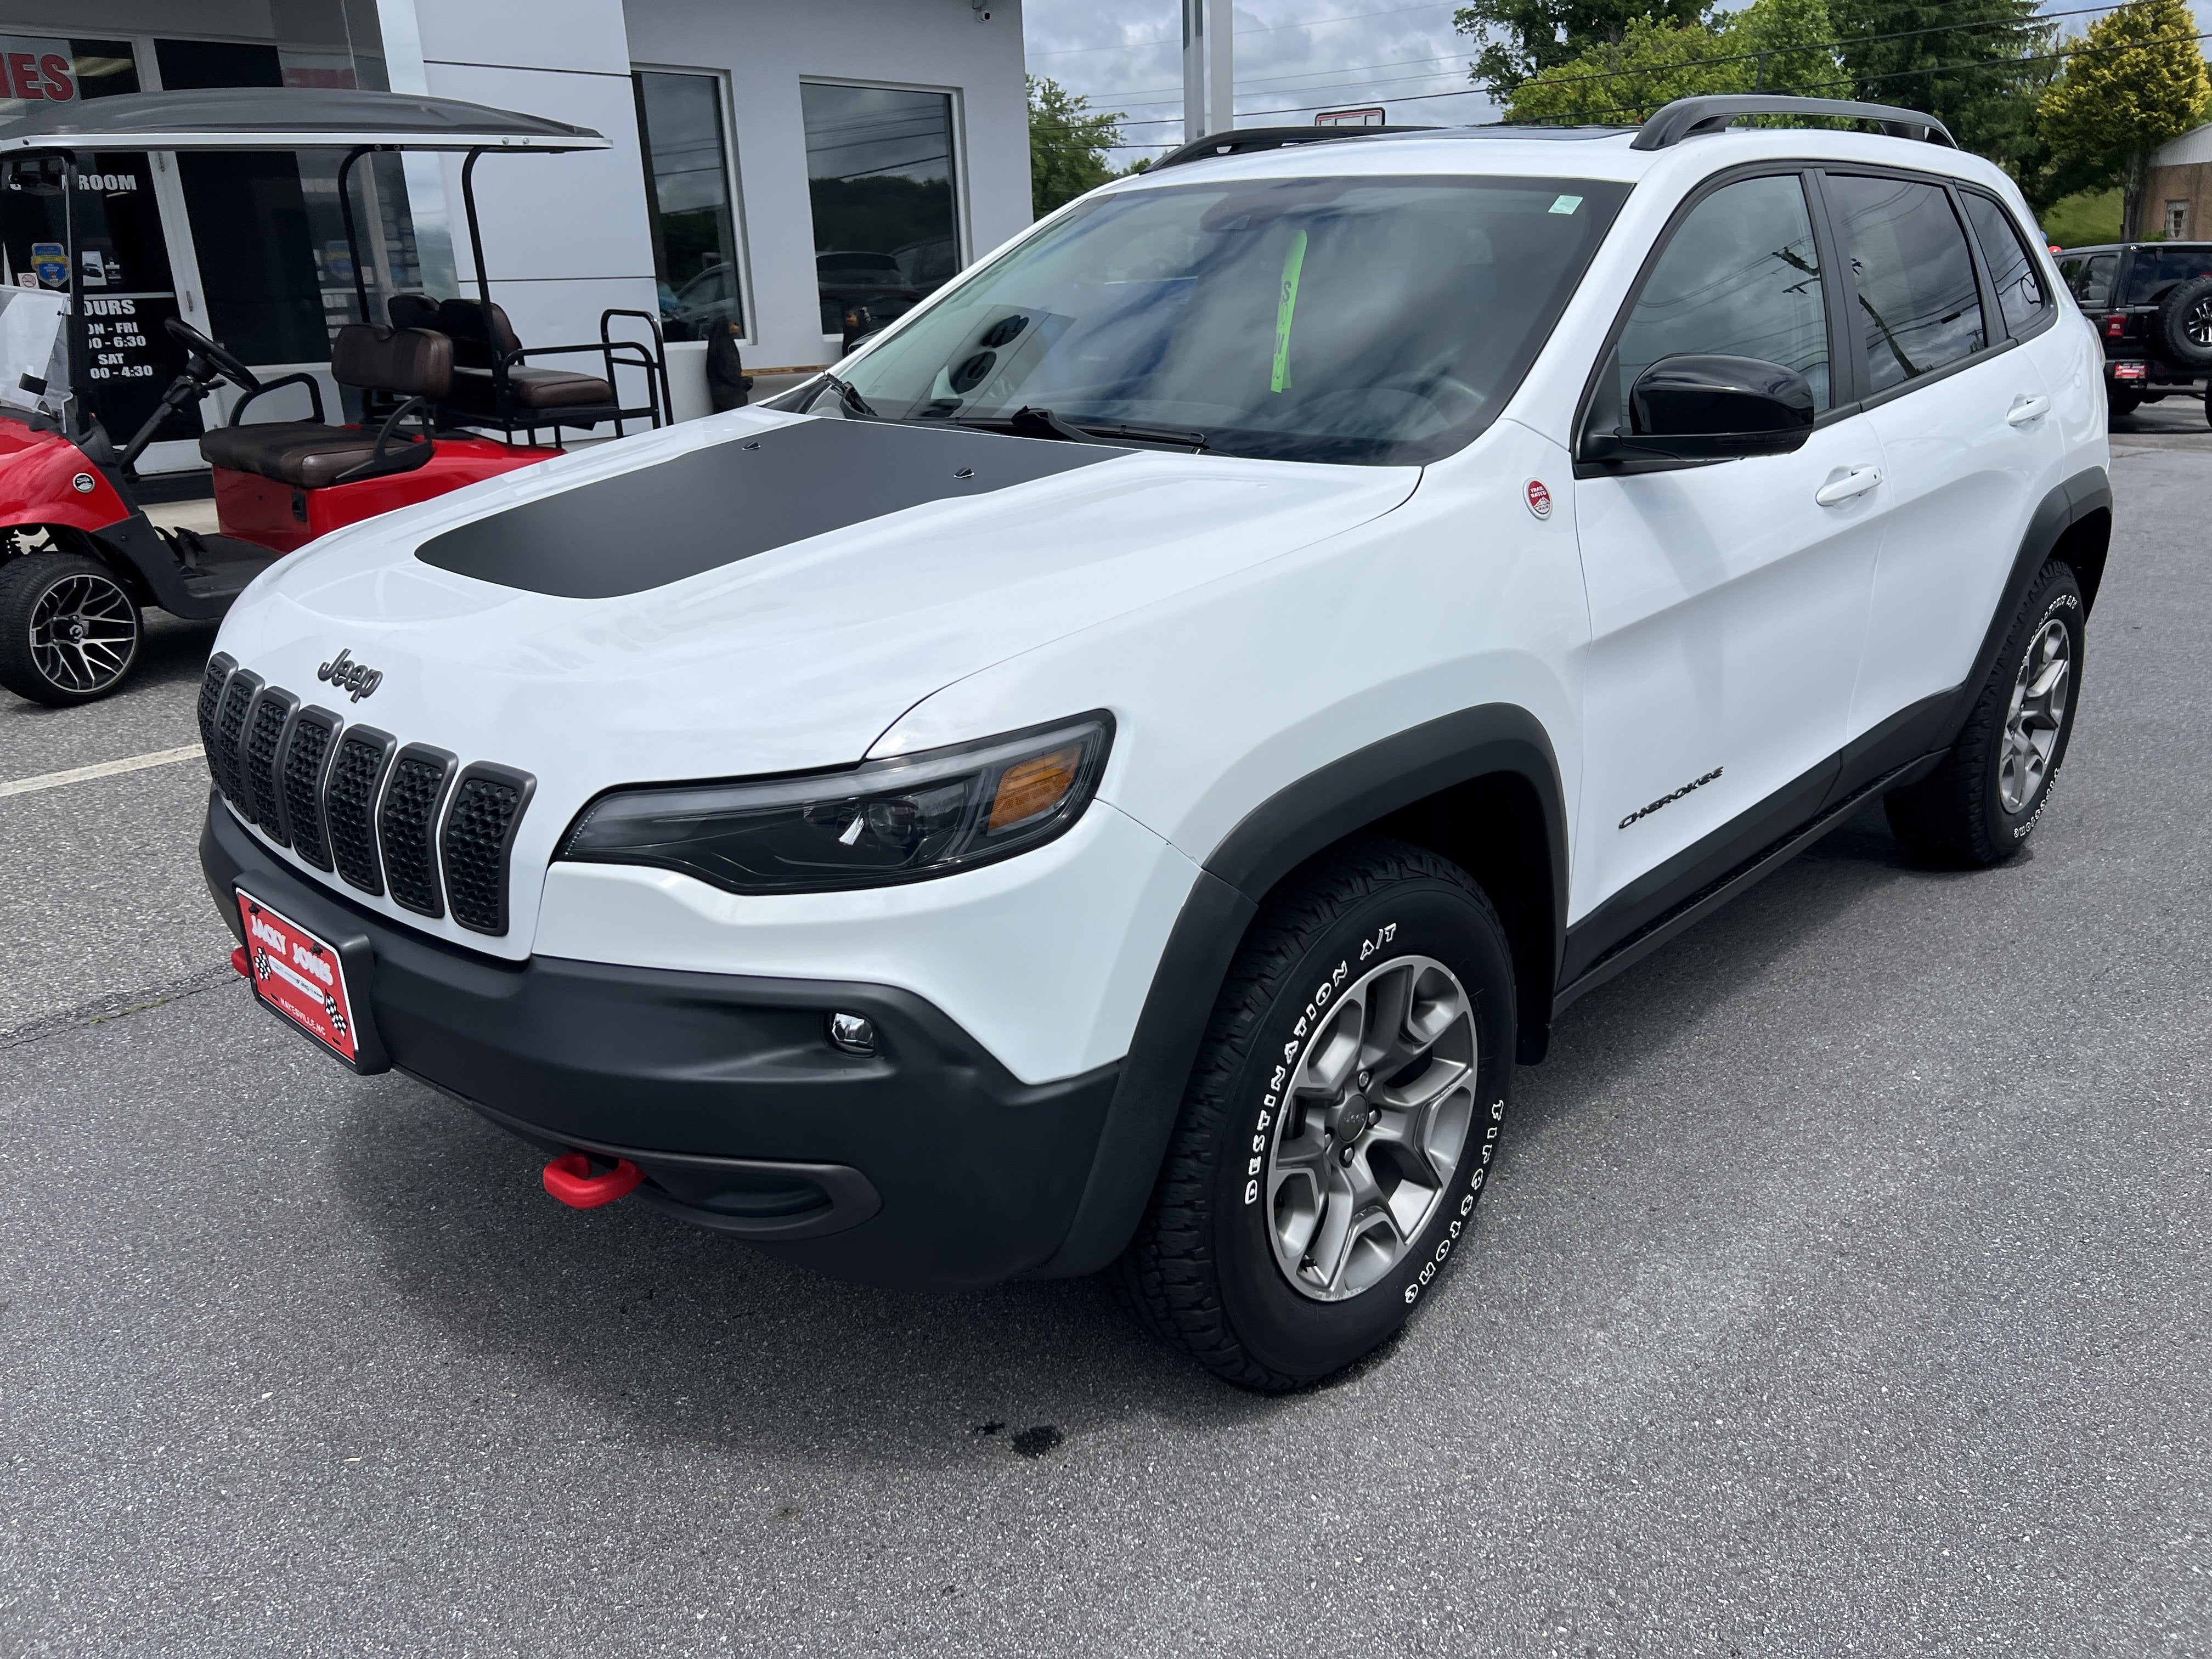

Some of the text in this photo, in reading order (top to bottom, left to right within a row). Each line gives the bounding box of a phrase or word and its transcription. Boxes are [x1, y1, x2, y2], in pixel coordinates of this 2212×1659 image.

[84, 299, 136, 316] OURS
[115, 322, 138, 333] FRI
[113, 335, 146, 347] 6:30
[98, 353, 124, 365] SAT
[90, 367, 110, 379] 00
[121, 365, 153, 377] 4:30
[317, 648, 383, 703] Jeep
[1618, 766, 1724, 829] CHEROKEE
[251, 915, 286, 955] JACKY
[293, 943, 334, 986] JONES
[1245, 923, 1397, 1205] DESTINATION A/T
